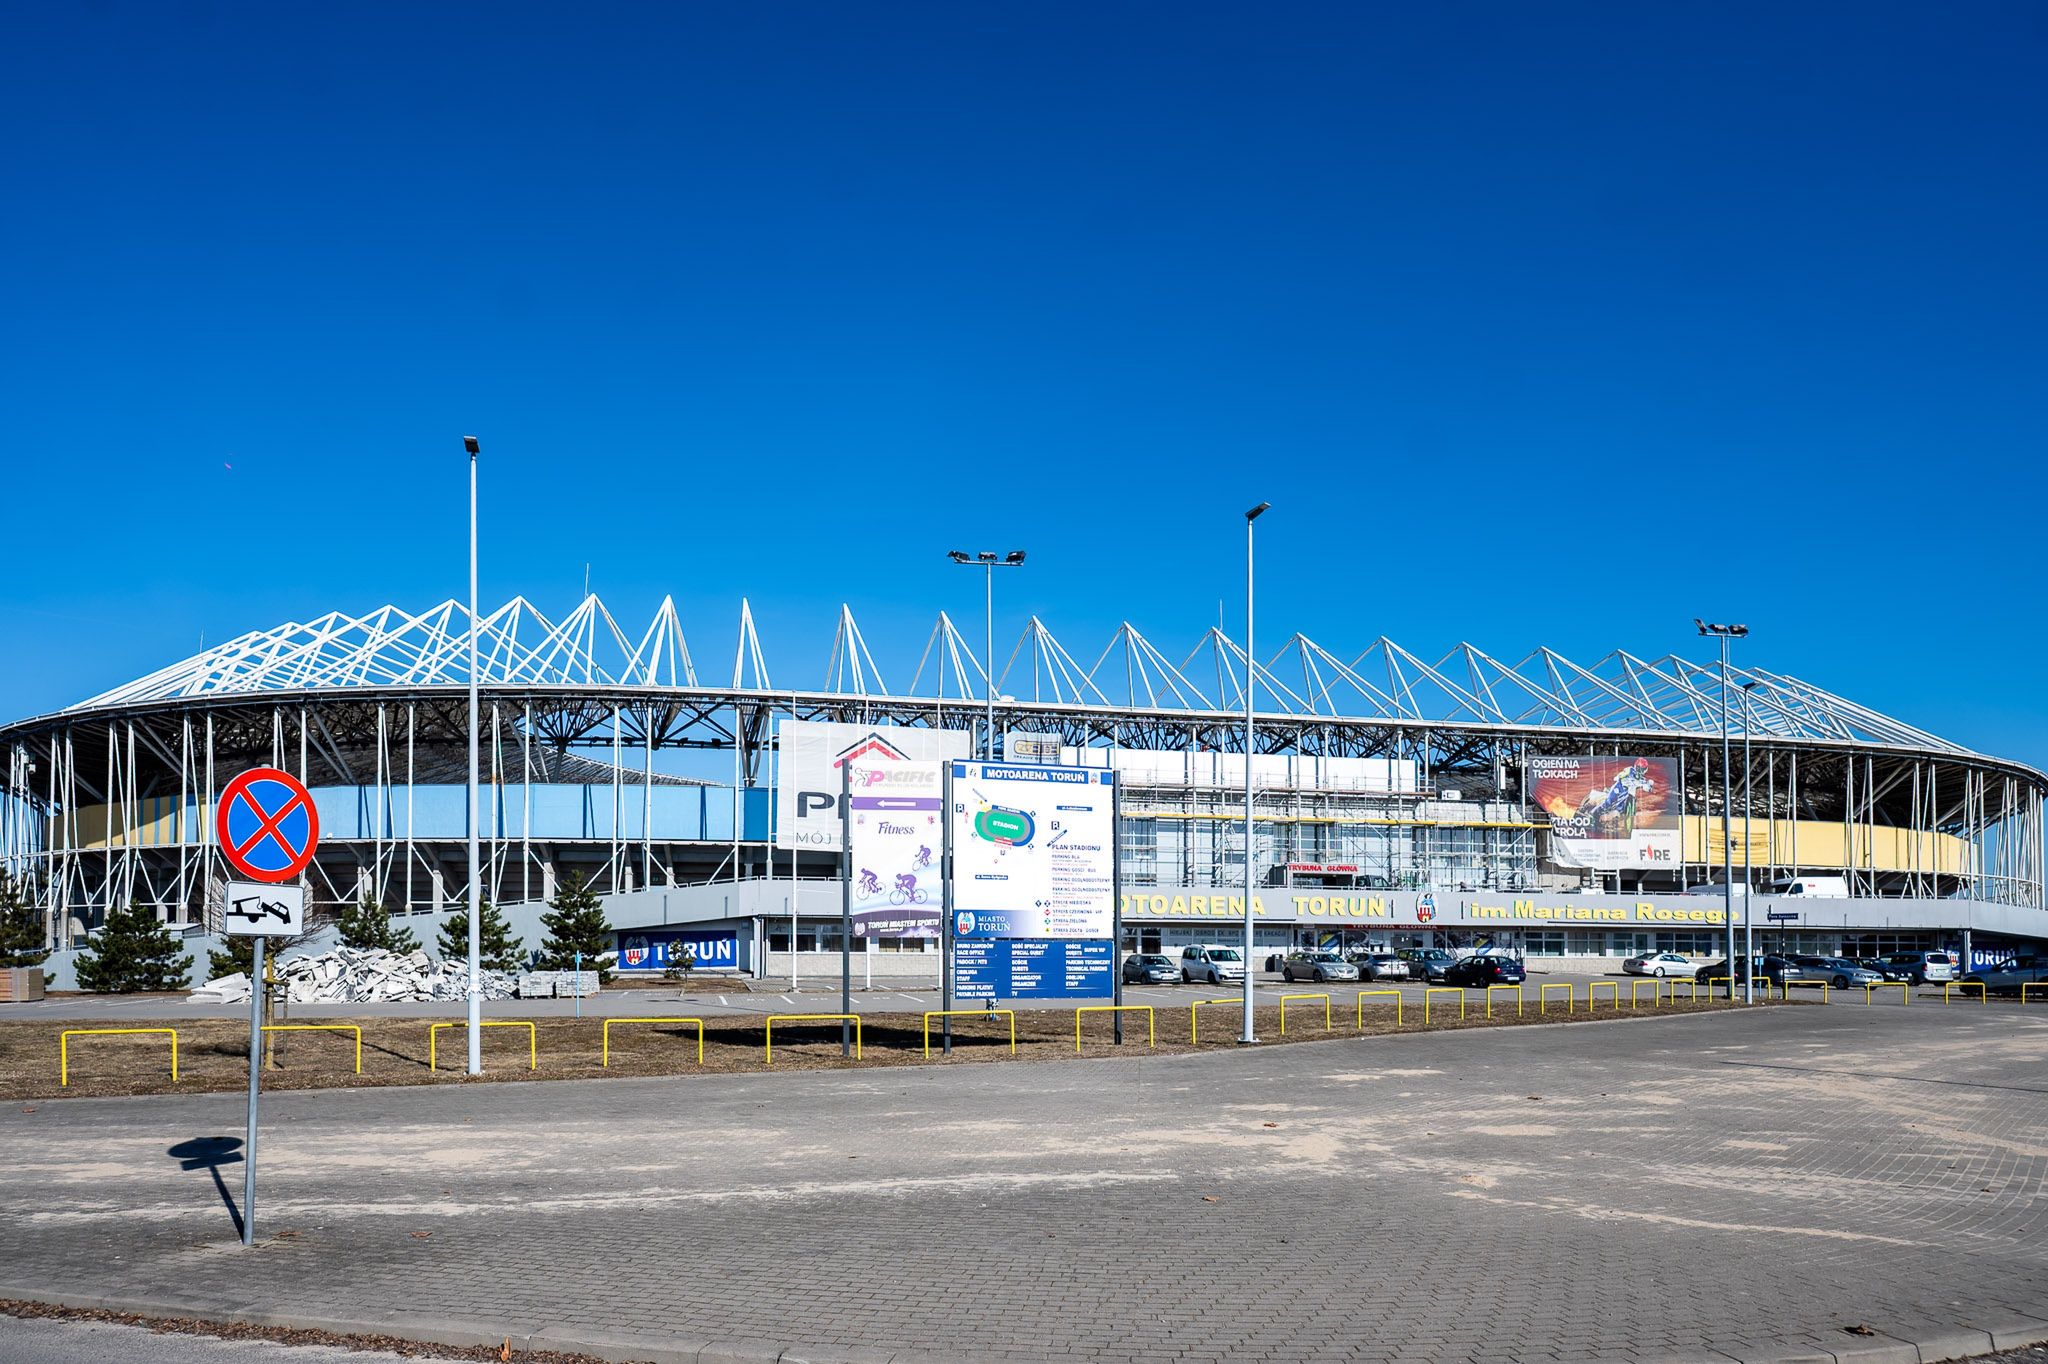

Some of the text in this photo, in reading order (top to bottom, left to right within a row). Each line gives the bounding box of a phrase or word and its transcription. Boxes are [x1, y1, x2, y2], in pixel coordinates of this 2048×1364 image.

[1532, 758, 1580, 769] OGIEŃ NA
[986, 769, 1085, 782] MOTOARENA TORUŃ
[1532, 769, 1578, 779] TŁOKACH
[992, 820, 1019, 831] STADION
[1569, 816, 1591, 827] POD
[878, 821, 915, 835] Fitness
[796, 831, 832, 845] MÓJ
[1292, 893, 1385, 917] TORUŃ
[1470, 902, 1510, 919] im.
[1514, 900, 1627, 920] Mariana
[978, 921, 1011, 931] TORUŃ
